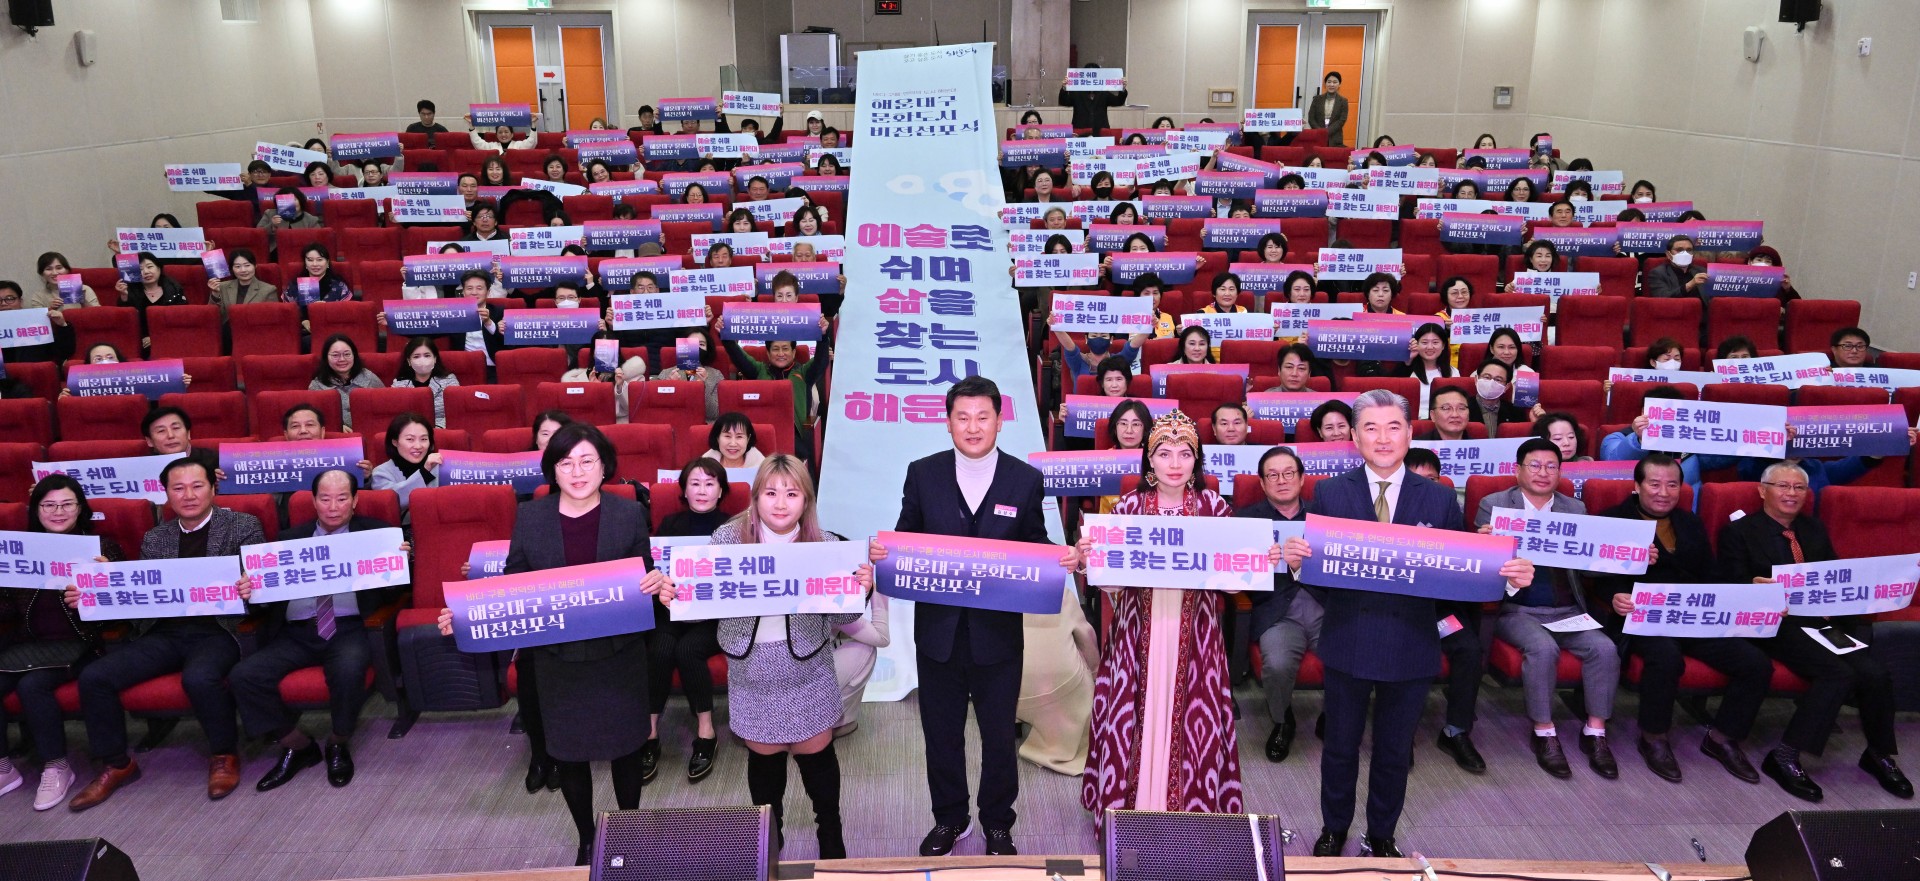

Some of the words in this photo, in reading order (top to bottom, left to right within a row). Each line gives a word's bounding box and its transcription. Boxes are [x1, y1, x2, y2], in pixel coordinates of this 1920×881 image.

[871, 95, 958, 109] 해운대구
[870, 110, 957, 123] 문화도시
[870, 120, 978, 137] 비전선포식
[857, 223, 994, 251] 예술로
[1017, 259, 1041, 268] 예술로
[1044, 259, 1059, 267] 쉬며
[1321, 253, 1345, 262] 예술로
[1348, 254, 1364, 262] 쉬며
[879, 255, 971, 283] 쉬며
[1017, 270, 1033, 279] 삶을
[1036, 270, 1052, 278] 찾는
[1054, 270, 1070, 278] 도시
[1073, 269, 1097, 278] 해운대
[1319, 264, 1336, 273] 삶을
[1339, 264, 1355, 272] 찾는
[1357, 264, 1373, 272] 도시
[1375, 264, 1399, 273] 해운대
[614, 300, 642, 310] 예술로
[645, 299, 662, 308] 쉬며
[875, 288, 976, 315] 삶을
[1055, 300, 1084, 311] 예술로
[1087, 302, 1106, 311] 쉬며
[394, 311, 428, 319] 해운대구
[431, 310, 466, 318] 문화도시
[615, 312, 633, 322] 삶을
[636, 311, 654, 321] 찾는
[657, 310, 674, 320] 도시
[677, 308, 703, 318] 해운대
[731, 315, 768, 323] 해운대구
[771, 316, 808, 324] 문화도시
[1054, 314, 1074, 324] 삶을
[1077, 313, 1096, 324] 찾는
[1099, 315, 1118, 324] 도시
[1122, 315, 1151, 325] 해운대
[396, 320, 439, 328] 비전선포식
[514, 321, 549, 329] 해운대구
[552, 320, 587, 329] 문화도시
[731, 326, 777, 334] 비전선포식
[515, 330, 558, 338] 비전선포식
[874, 321, 980, 351] 찾는
[1318, 334, 1356, 342] 해운대구
[1360, 335, 1398, 344] 문화도시
[1317, 344, 1365, 353] 비전선포식
[875, 357, 982, 386] 도시
[844, 392, 1018, 424] 해운
[1648, 406, 1689, 421] 예술로
[1694, 409, 1720, 424] 쉬며
[1646, 423, 1675, 439] 삶을
[1679, 425, 1706, 440] 찾는
[1711, 428, 1737, 442] 도시
[1743, 430, 1784, 445] 해운대
[234, 459, 288, 472] 해운대구
[292, 456, 345, 469] 문화도시
[1042, 464, 1089, 476] 해운대구
[1094, 463, 1140, 475] 문화도시
[235, 471, 302, 485] 비전선포식
[1495, 516, 1541, 534] 예술로
[1546, 521, 1577, 537] 쉬며
[1089, 526, 1143, 545] 예술로
[1149, 527, 1183, 546] 쉬며
[1417, 540, 1444, 551] 해운대
[1527, 537, 1558, 553] 찾는
[1563, 541, 1594, 557] 도시
[1600, 544, 1647, 562] 해운대
[245, 549, 293, 567] 예술로
[299, 545, 330, 563] 쉬며
[982, 551, 1006, 560] 해운대
[1090, 550, 1125, 569] 삶을
[1130, 550, 1166, 570] 찾는
[1172, 552, 1206, 571] 도시
[1214, 553, 1269, 573] 해운대
[1324, 542, 1398, 564] 해운대구
[1405, 550, 1481, 574] 문화도시
[250, 573, 279, 590] 삶을
[284, 568, 316, 585] 찾는
[322, 562, 352, 580] 도시
[357, 556, 403, 575] 해운대
[676, 557, 733, 577] 예술로
[739, 556, 775, 575] 쉬며
[896, 557, 964, 577] 해운대구
[971, 560, 1040, 583] 문화도시
[1323, 561, 1415, 583] 비전선포식
[76, 572, 125, 588] 예술로
[131, 570, 161, 585] 쉬며
[895, 576, 981, 596] 비전선포식
[1777, 571, 1819, 588] 예술로
[1824, 569, 1851, 584] 쉬며
[81, 591, 113, 607] 삶을
[116, 591, 148, 605] 찾는
[153, 589, 184, 604] 도시
[190, 584, 237, 603] 해운대
[675, 583, 713, 601] 삶을
[719, 581, 757, 599] 찾는
[763, 579, 799, 597] 도시
[805, 577, 863, 596] 해운대
[1808, 589, 1837, 604] 찾는
[1841, 586, 1869, 602] 도시
[1874, 581, 1915, 598] 해운대
[468, 598, 543, 623] 해운대구
[550, 586, 624, 611] 문화도시
[1635, 592, 1681, 606] 예술로
[1686, 593, 1716, 607] 쉬며
[1630, 609, 1663, 624] 삶을
[1666, 609, 1696, 624] 찾는
[1701, 612, 1731, 625] 도시
[1734, 611, 1781, 626] 해운대
[469, 613, 565, 640] 비전선포식
